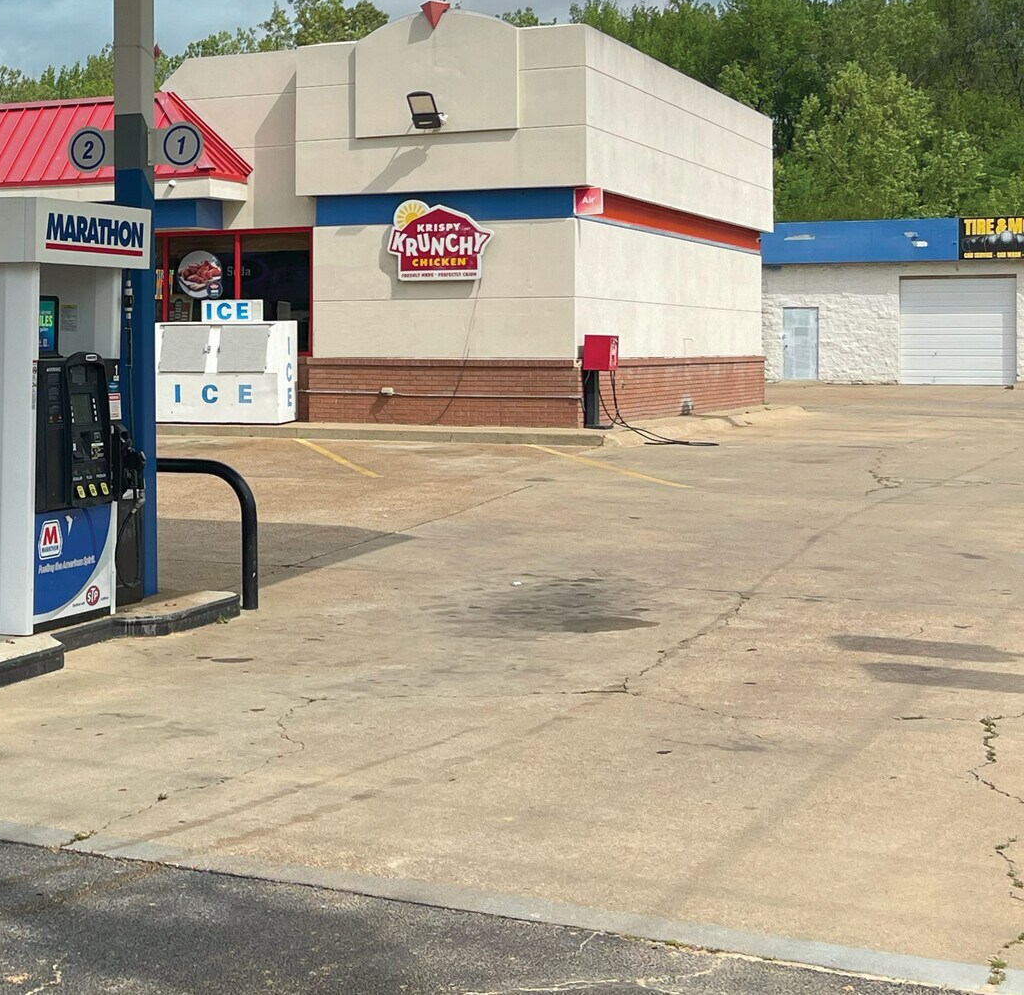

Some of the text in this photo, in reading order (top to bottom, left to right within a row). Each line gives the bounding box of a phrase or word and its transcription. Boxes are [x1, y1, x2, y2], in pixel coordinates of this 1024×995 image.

[82, 140, 95, 159] 2
[177, 136, 186, 155] 1
[582, 196, 596, 204] Air
[47, 212, 144, 249] MARATHON
[417, 223, 461, 232] KRISPY
[964, 218, 994, 235] TIRE
[392, 231, 491, 257] KRUNCHY
[412, 257, 467, 267] CHICKEN
[206, 302, 249, 320] ICE
[175, 384, 253, 403] ICE
[43, 526, 58, 545] M
[87, 587, 99, 603] STP
